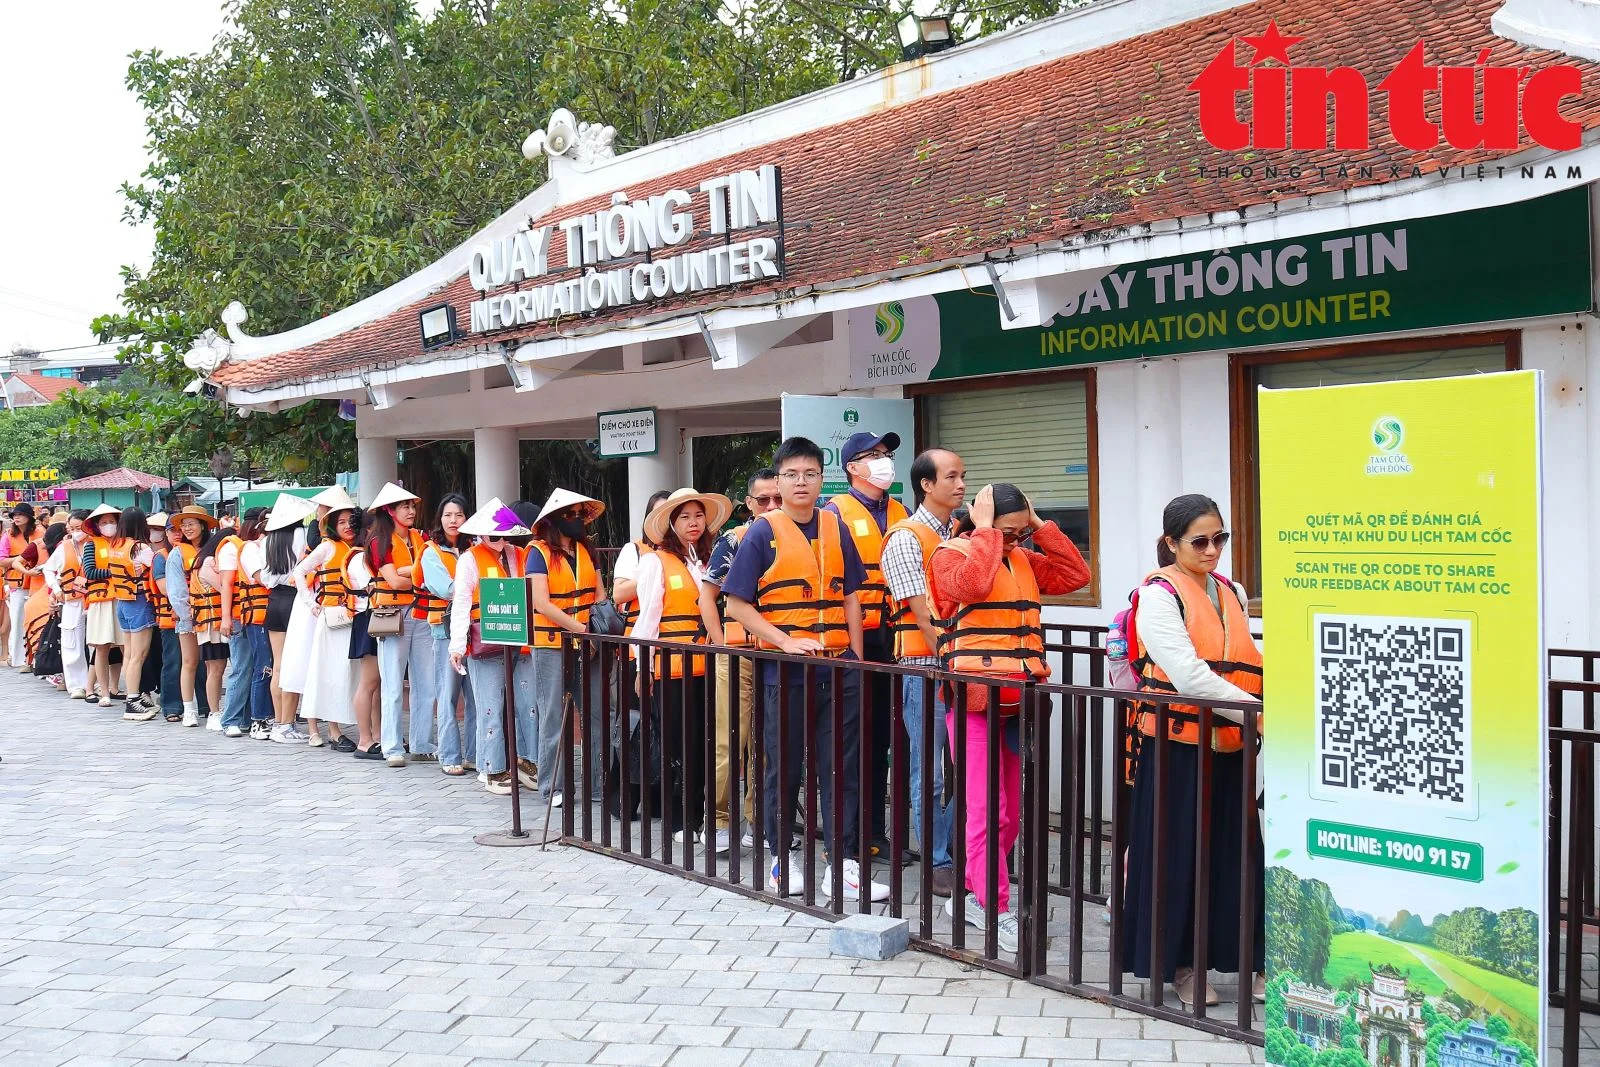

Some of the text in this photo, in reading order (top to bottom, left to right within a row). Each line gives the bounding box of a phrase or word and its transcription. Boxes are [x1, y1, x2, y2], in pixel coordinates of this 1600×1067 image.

[559, 191, 693, 268] THÔNG
[700, 165, 777, 235] TIN
[631, 238, 779, 301] COUNTER
[1147, 244, 1308, 304] THÔNG
[1322, 229, 1408, 280] TIN
[1041, 290, 1391, 356] INFORMATION COUNTER
[872, 353, 890, 365] TAM
[632, 419, 640, 428] XE
[1370, 456, 1387, 464] TAM
[1306, 512, 1340, 528] QUÉT
[1343, 512, 1364, 526] MÃ
[1366, 514, 1387, 528] QR
[1411, 511, 1453, 526] ĐÁNH
[1456, 511, 1482, 526] GIÁ
[1278, 526, 1512, 546] DỊCH VỤ TẠI KHU DU LỊCH TAM CỐC
[1295, 562, 1496, 578] SCAN THE QR CODE TO SHARE
[1283, 577, 1511, 595] YOUR FEEDBACK ABOUT TAM COC
[1317, 830, 1470, 870] HOTLINE: 1900 91 57
